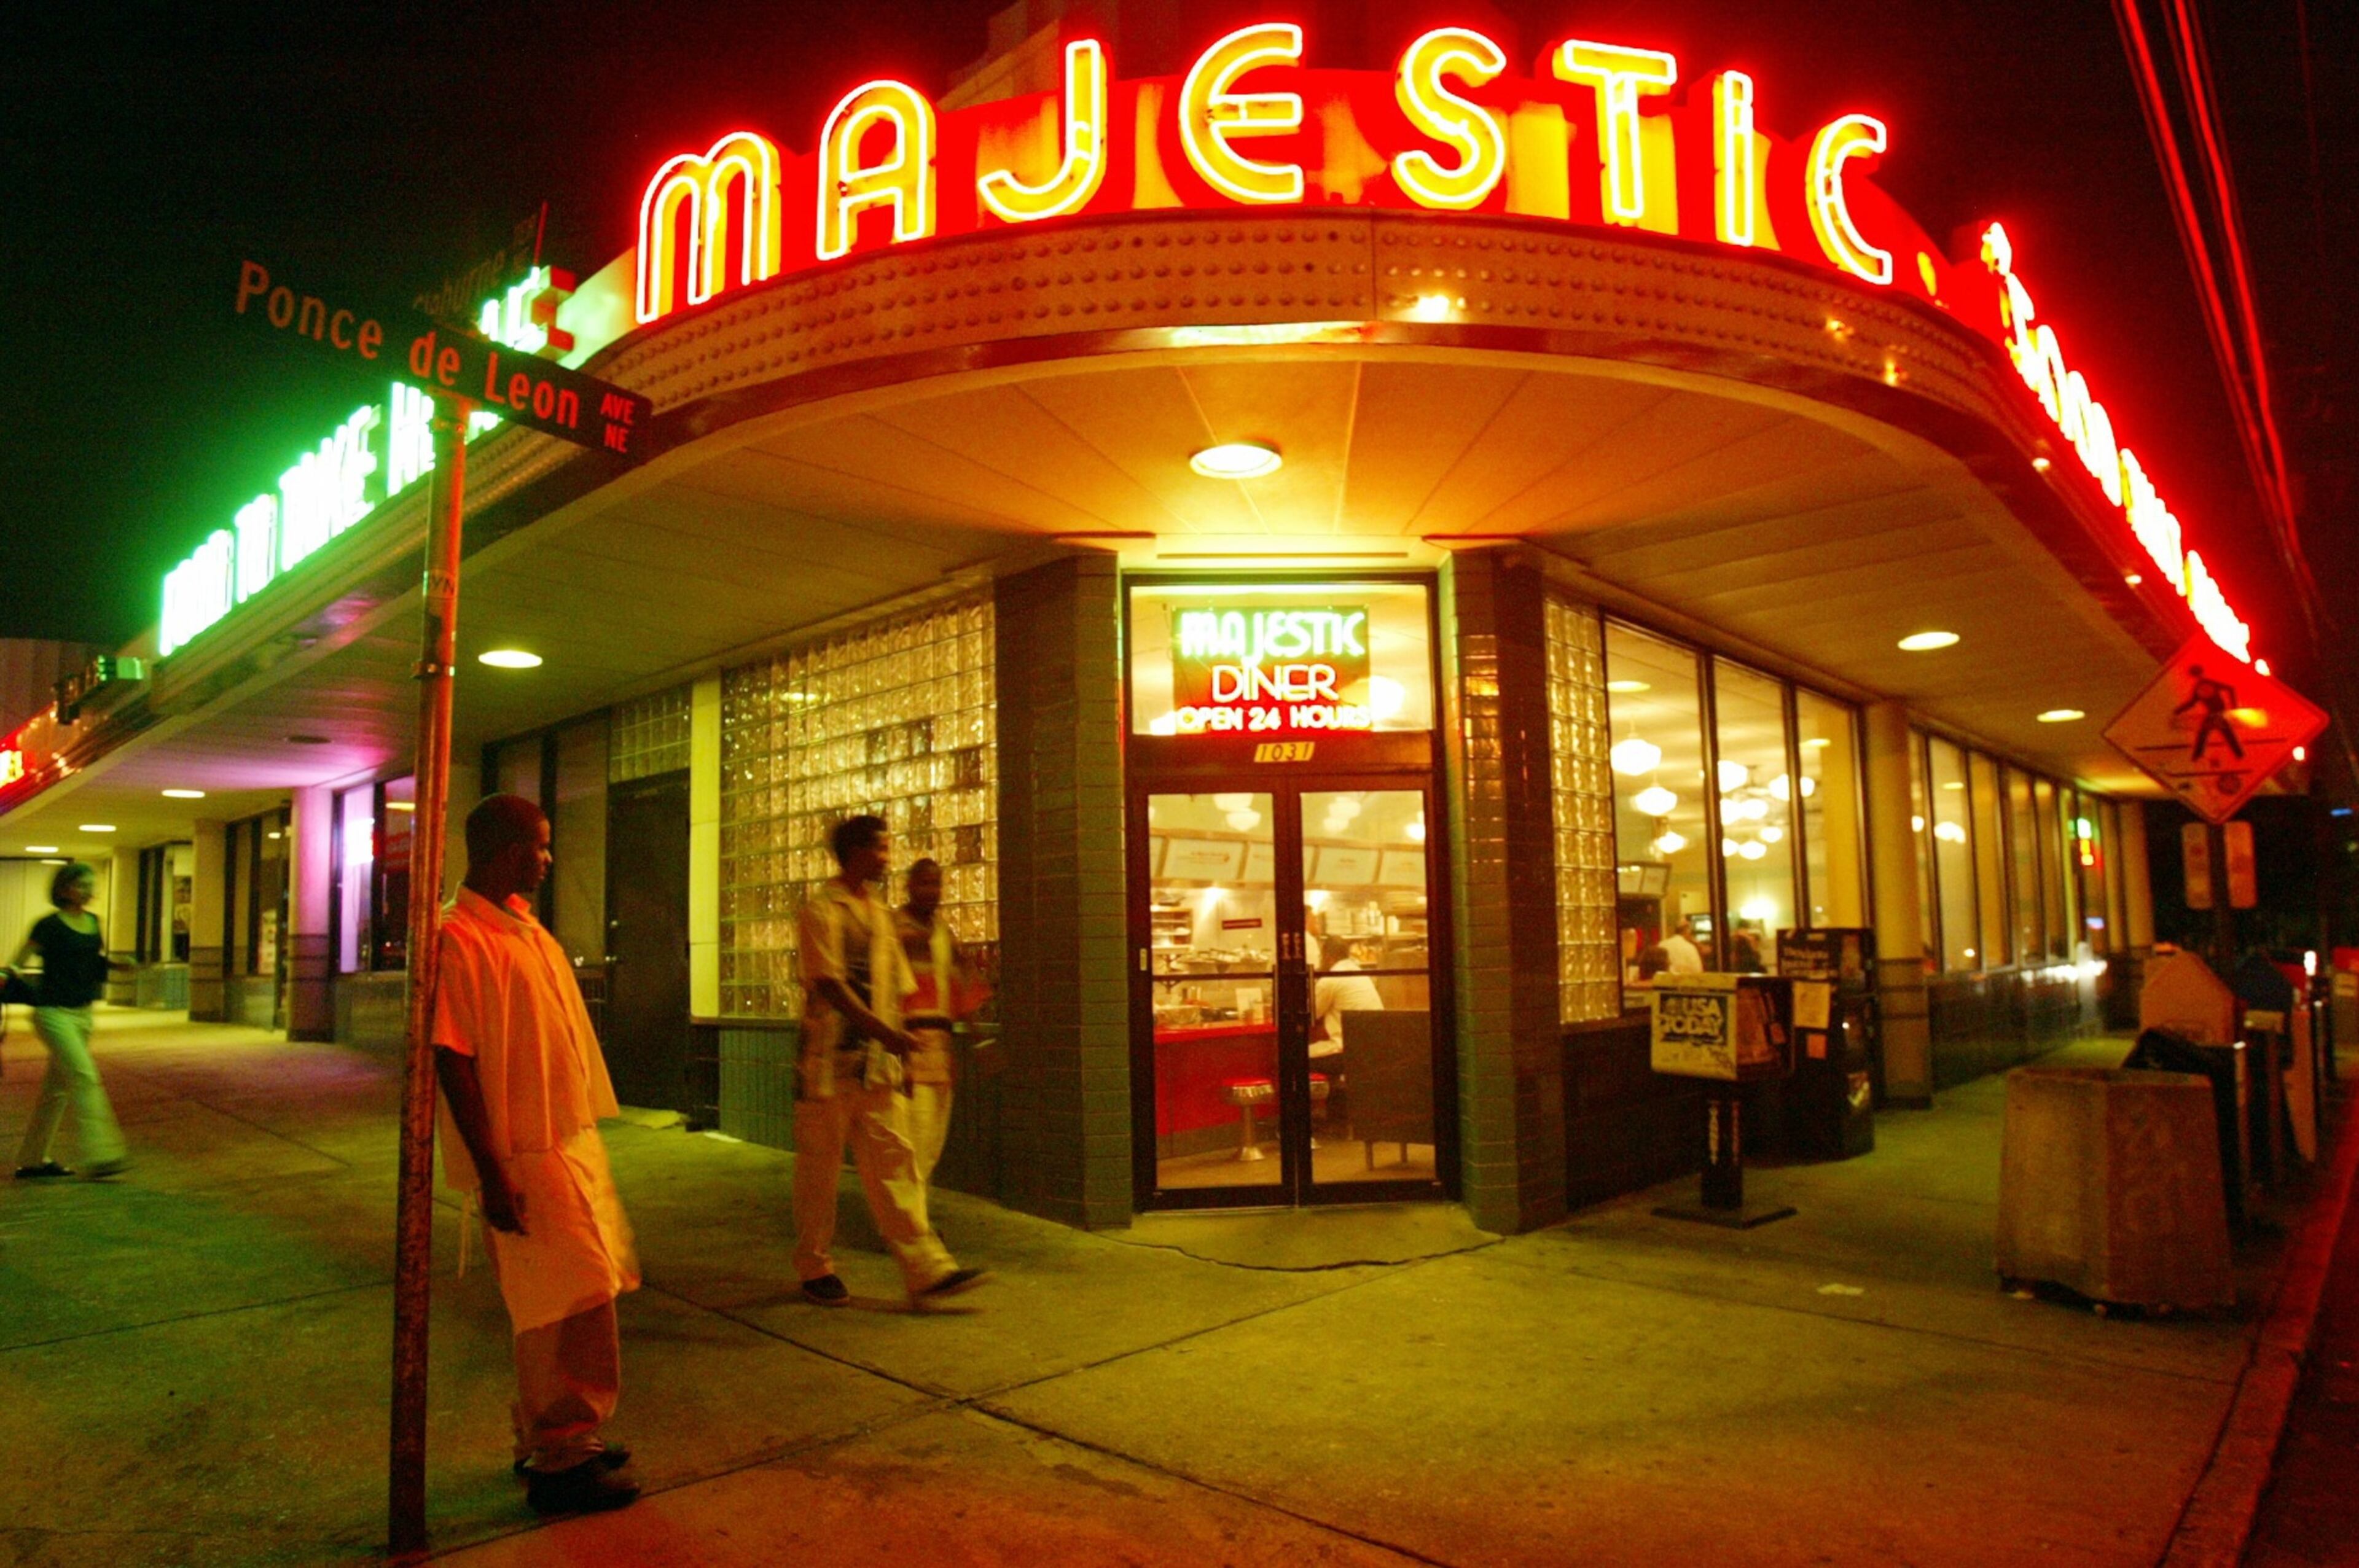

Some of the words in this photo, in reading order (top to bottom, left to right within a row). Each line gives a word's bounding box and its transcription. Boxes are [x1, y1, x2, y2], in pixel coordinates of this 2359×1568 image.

[636, 22, 1894, 324] MAJESTIC
[236, 260, 384, 360] Ponce
[409, 332, 461, 386] de
[485, 352, 579, 429] Leon
[600, 392, 635, 425] AVE
[604, 423, 629, 453] NE
[1179, 610, 1365, 668] MAJESTIC
[1211, 664, 1339, 703] DINER
[1176, 706, 1243, 730] OPEN
[1248, 706, 1281, 730] 24
[1290, 704, 1371, 728] HOURS
[1259, 743, 1314, 761] 1031
[1682, 997, 1721, 1015] USA
[1659, 1013, 1723, 1036] TODAY
